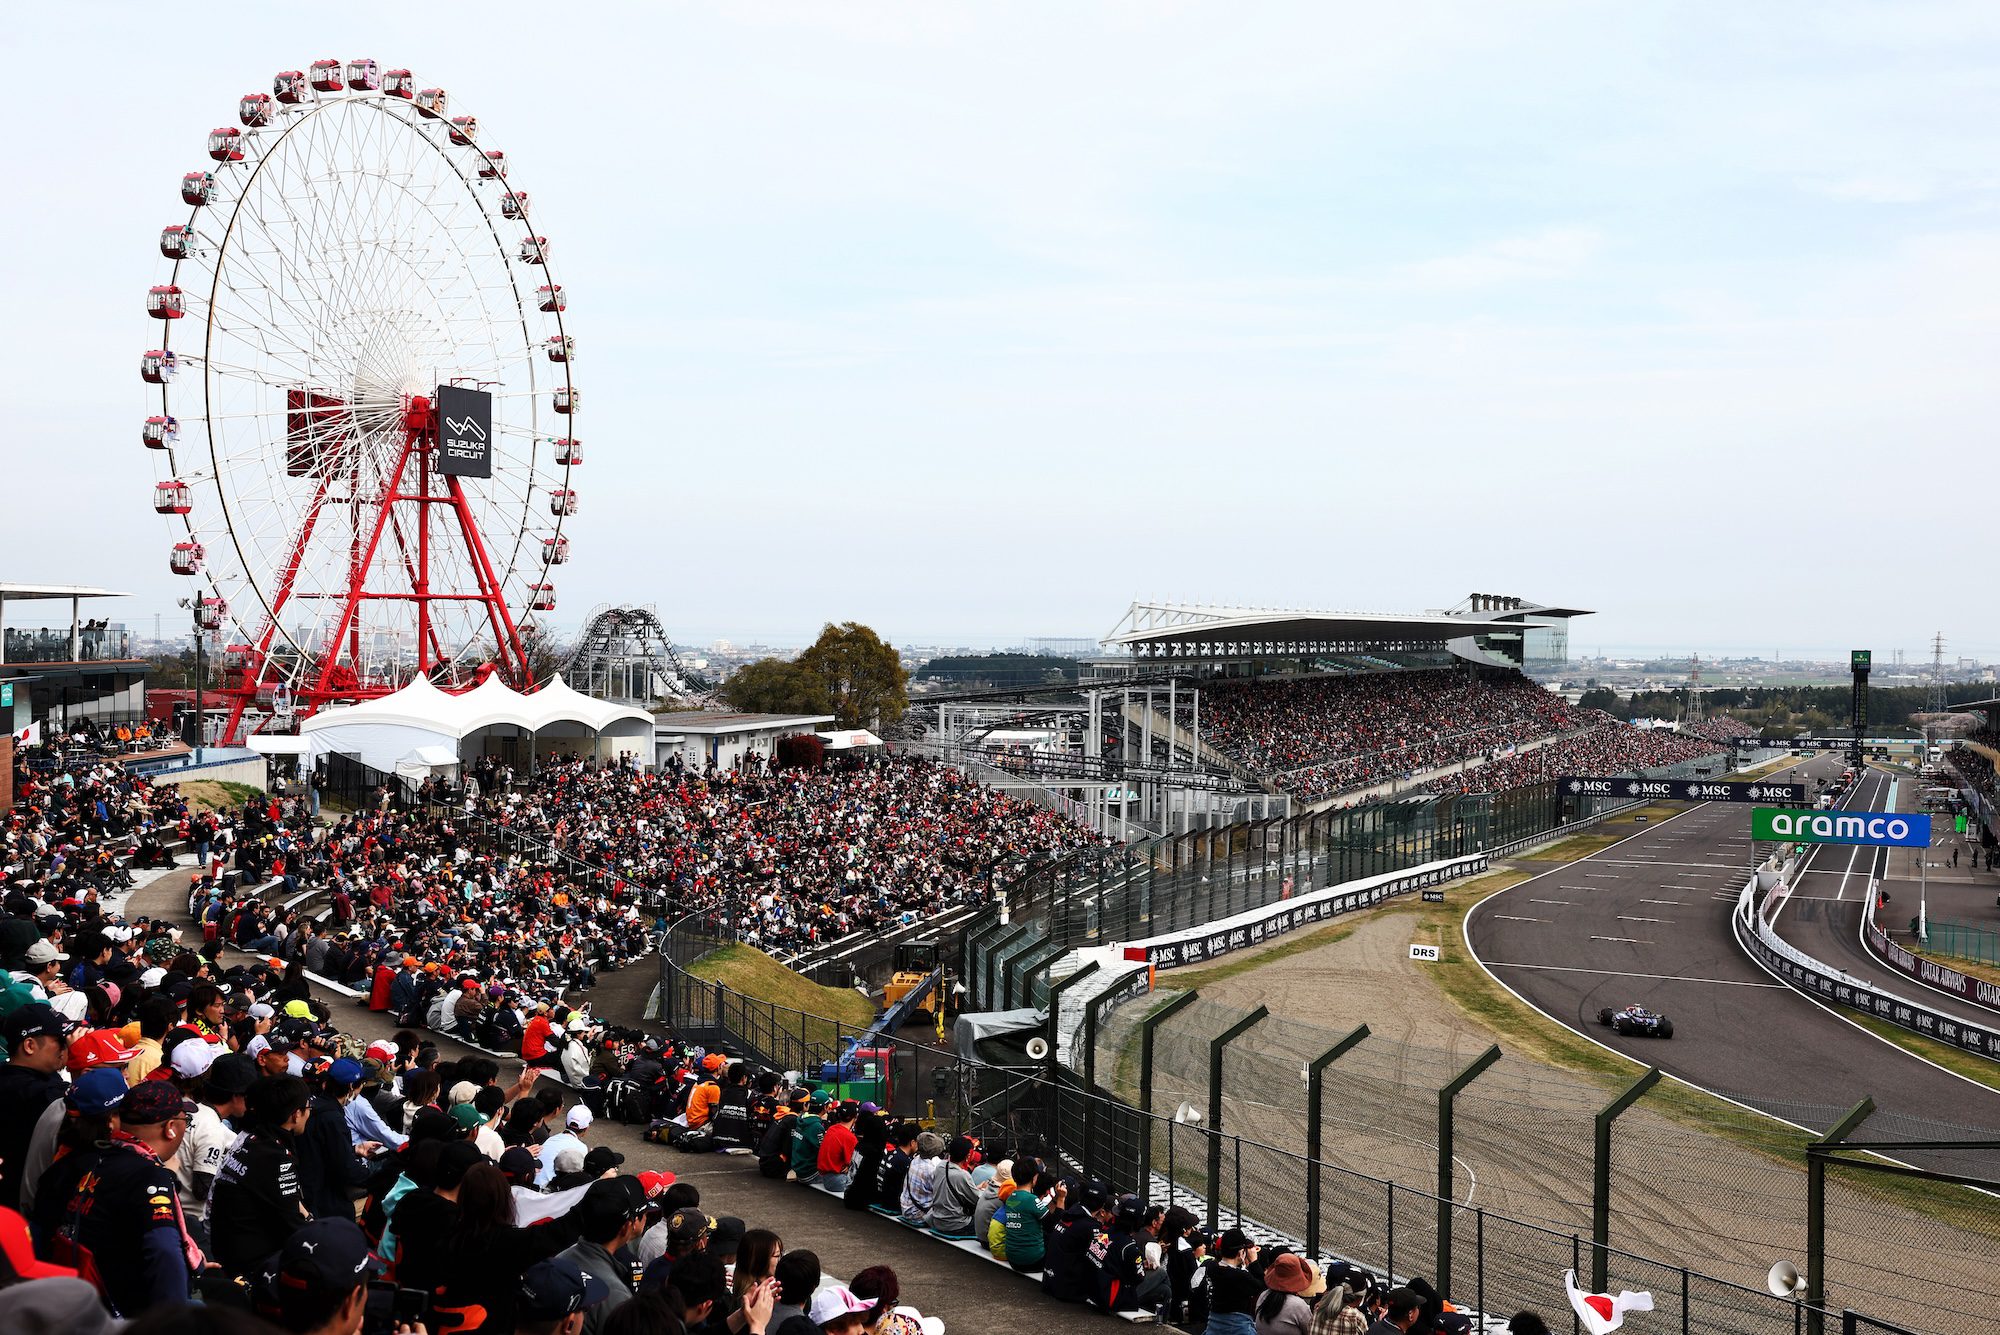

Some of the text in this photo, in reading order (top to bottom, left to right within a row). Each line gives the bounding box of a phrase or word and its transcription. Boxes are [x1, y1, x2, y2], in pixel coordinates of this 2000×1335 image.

[447, 438, 485, 451] SUZUKA
[448, 448, 484, 460] CIRCUIT
[1583, 781, 1612, 791] MSC
[1642, 783, 1670, 793] MSC
[1701, 785, 1730, 796] MSC
[1762, 787, 1792, 798] MSC
[1771, 814, 1909, 841] aramco
[1213, 935, 1225, 951] MSC
[1234, 929, 1245, 944] MSC
[1159, 947, 1176, 962] MSC
[1189, 942, 1202, 956] MSC
[1413, 948, 1435, 957] DRS
[1921, 960, 1966, 993] QATAR AIRWAYS
[1859, 992, 1870, 1006] MSC
[1976, 981, 2000, 1006] QATAR
[1879, 999, 1890, 1013] MSC
[1900, 1007, 1911, 1021] MSC
[1921, 1014, 1933, 1029] MSC
[1944, 1022, 1956, 1038] MSC
[1968, 1030, 1981, 1046] MSC
[207, 1147, 220, 1160] 19
